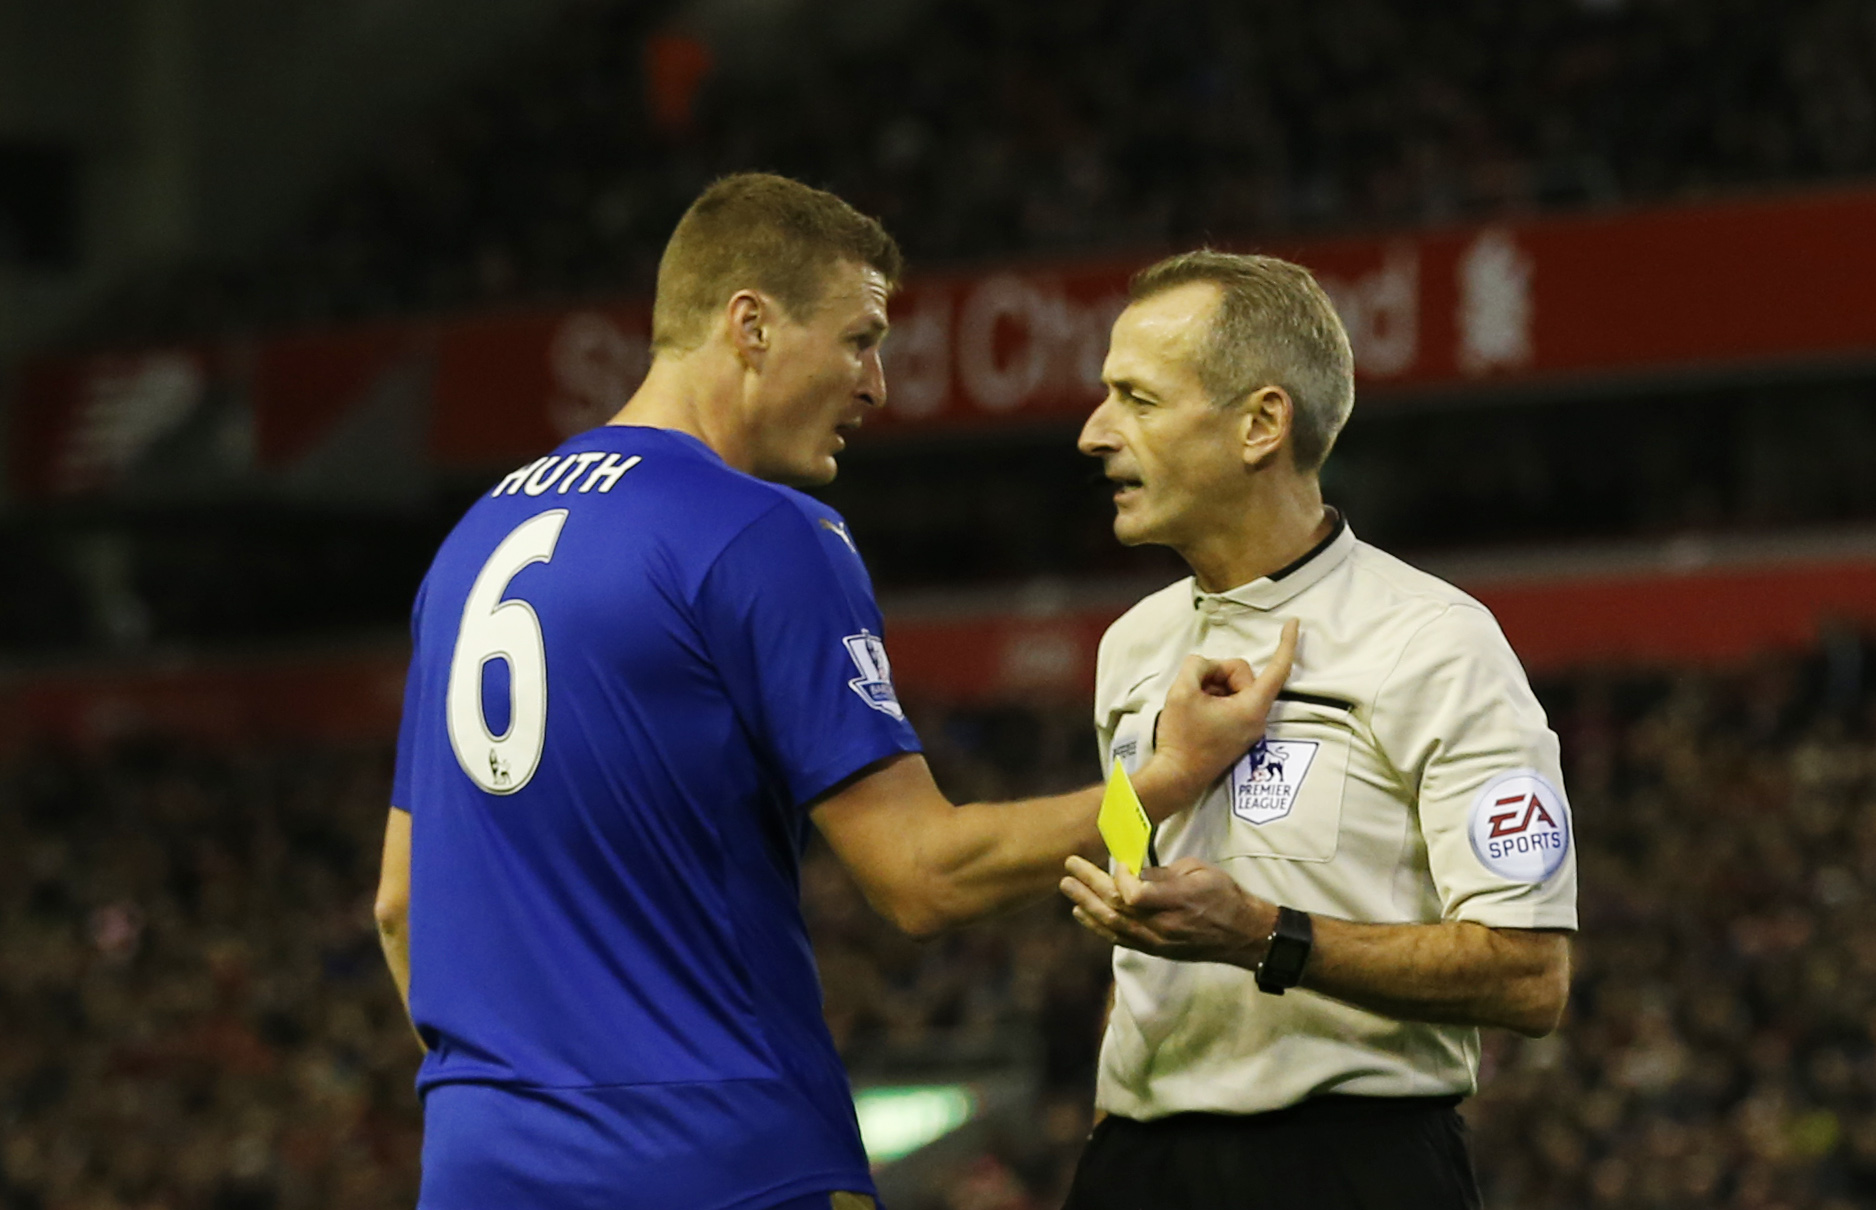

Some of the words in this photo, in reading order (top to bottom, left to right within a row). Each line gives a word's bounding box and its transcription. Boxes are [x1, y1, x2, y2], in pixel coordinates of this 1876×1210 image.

[491, 451, 643, 498] HUTH
[446, 508, 569, 796] 6
[1238, 784, 1292, 797] PREMIER
[1238, 797, 1288, 810] LEAGUE
[1488, 792, 1558, 839] EA
[1488, 831, 1562, 859] SPORTS
